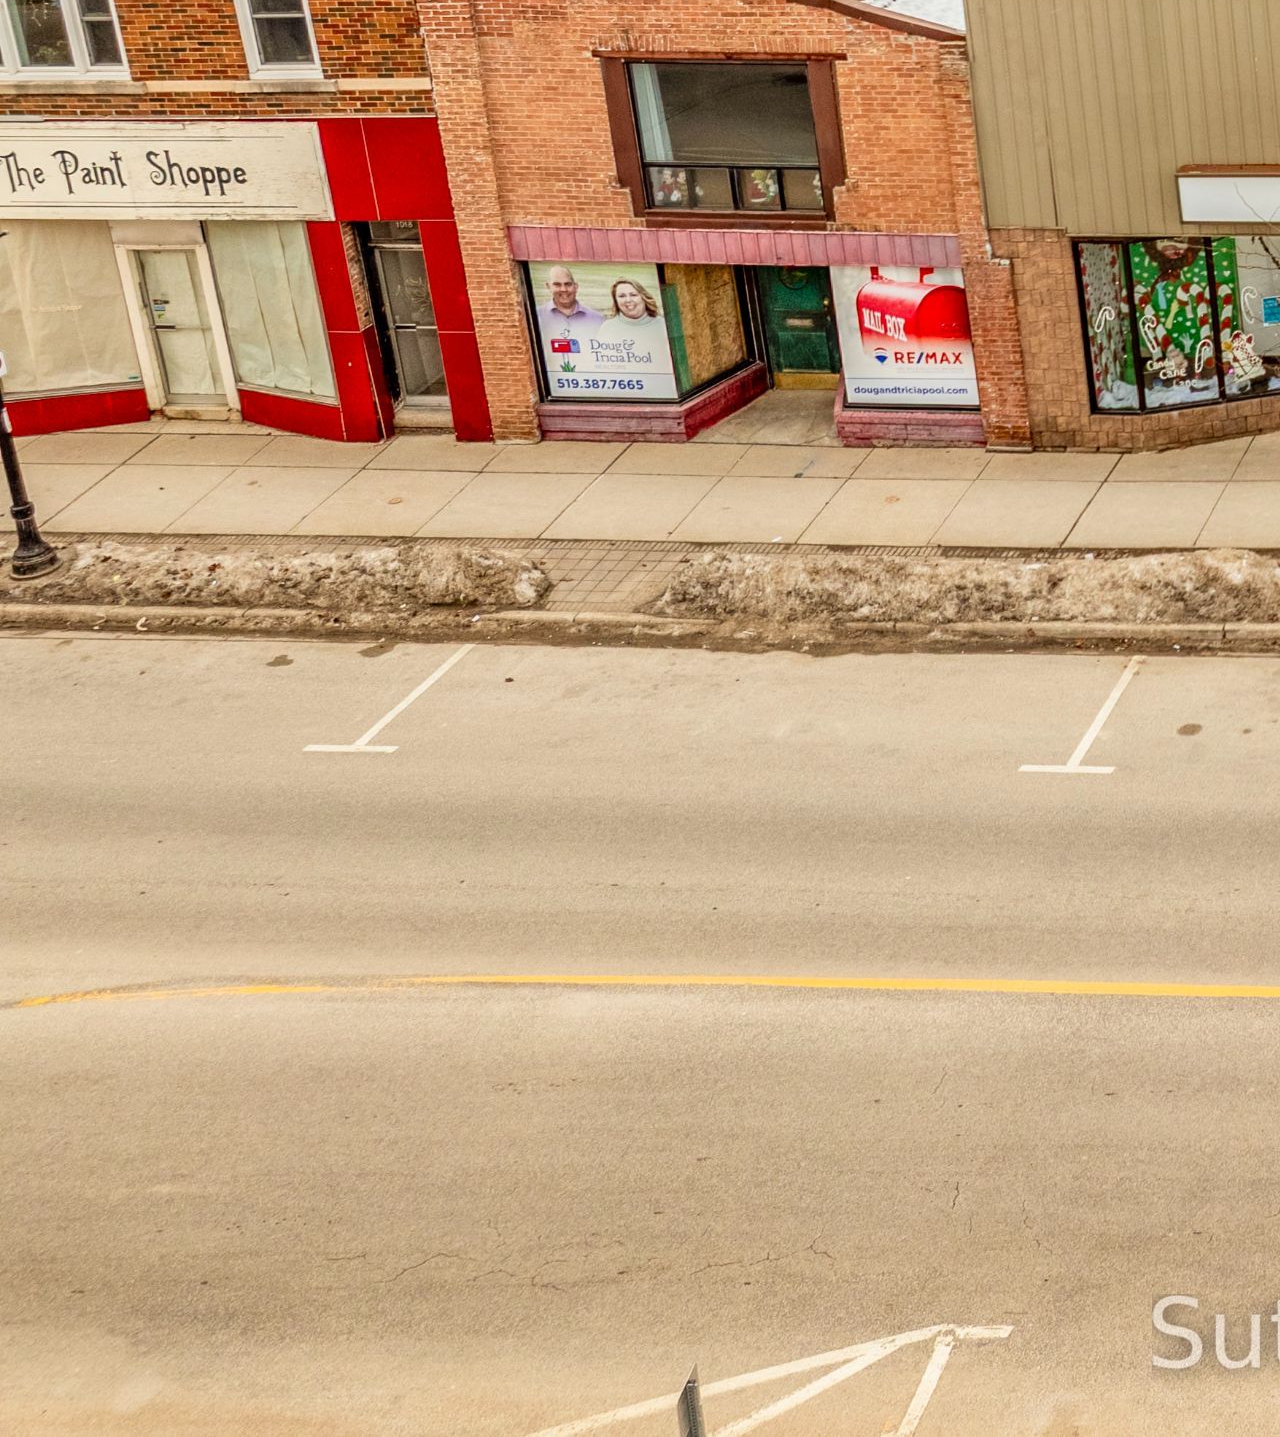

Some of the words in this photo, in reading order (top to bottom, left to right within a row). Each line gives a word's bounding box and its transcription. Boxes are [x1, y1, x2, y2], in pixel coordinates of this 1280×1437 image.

[0, 151, 46, 193] The
[51, 150, 127, 194] Paint
[146, 150, 248, 196] Shoppe
[862, 307, 885, 334] MAIL
[885, 314, 908, 342] BOX
[589, 338, 623, 354] Doug
[592, 350, 625, 363] Tricia
[626, 351, 652, 363] Pool
[893, 351, 963, 364] RE/MAX
[557, 378, 645, 390] 519.387.7665
[854, 386, 969, 395] dougandtriciapool.com
